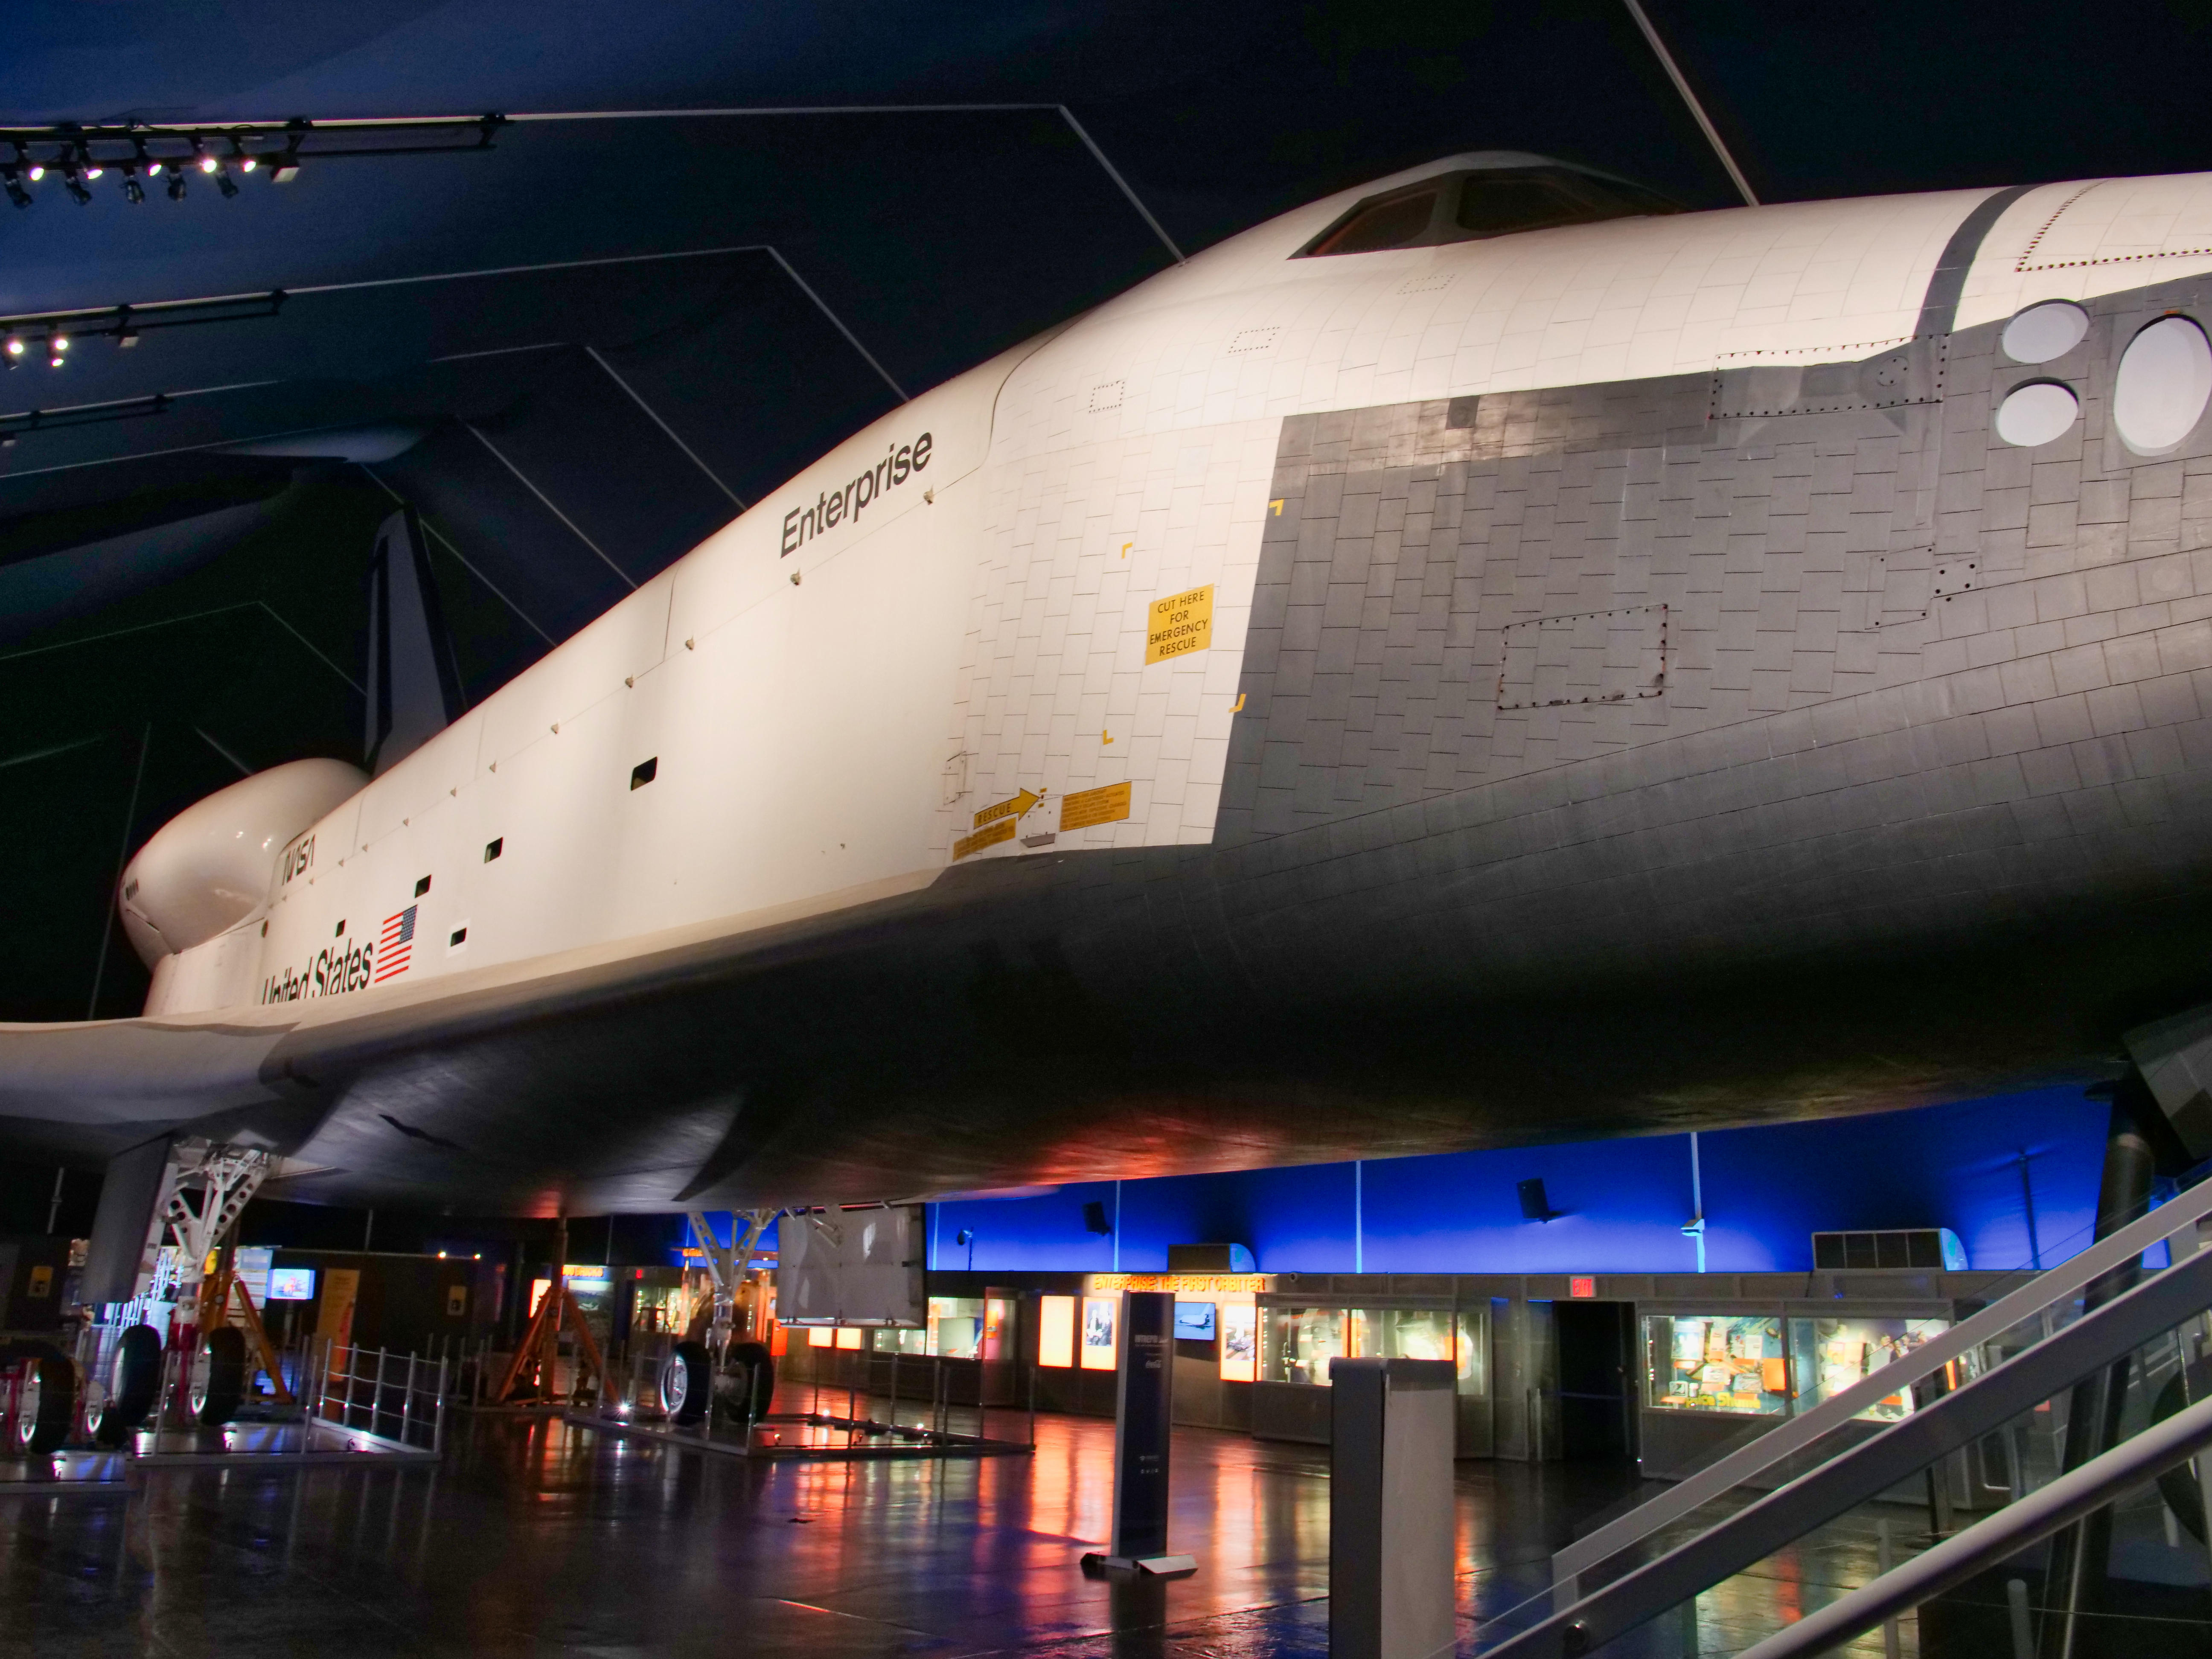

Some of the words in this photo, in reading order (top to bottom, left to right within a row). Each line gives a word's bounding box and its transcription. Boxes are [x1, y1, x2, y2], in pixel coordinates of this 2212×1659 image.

[780, 432, 933, 559] Enterprise
[1158, 599, 1176, 613] CUT
[1179, 591, 1205, 607] HERE
[1170, 610, 1189, 624] FOR
[1150, 618, 1208, 645] EMERGENCY
[1159, 637, 1196, 656] RESCUE
[978, 803, 1011, 824] RESCUE
[282, 833, 315, 885] NASA
[262, 956, 312, 1005] United
[312, 937, 373, 998] States
[1094, 1275, 1158, 1290] ENTERPRISE:
[1159, 1276, 1180, 1291] THE
[1181, 1276, 1213, 1292] FIRST
[1215, 1277, 1266, 1292] ORBITER
